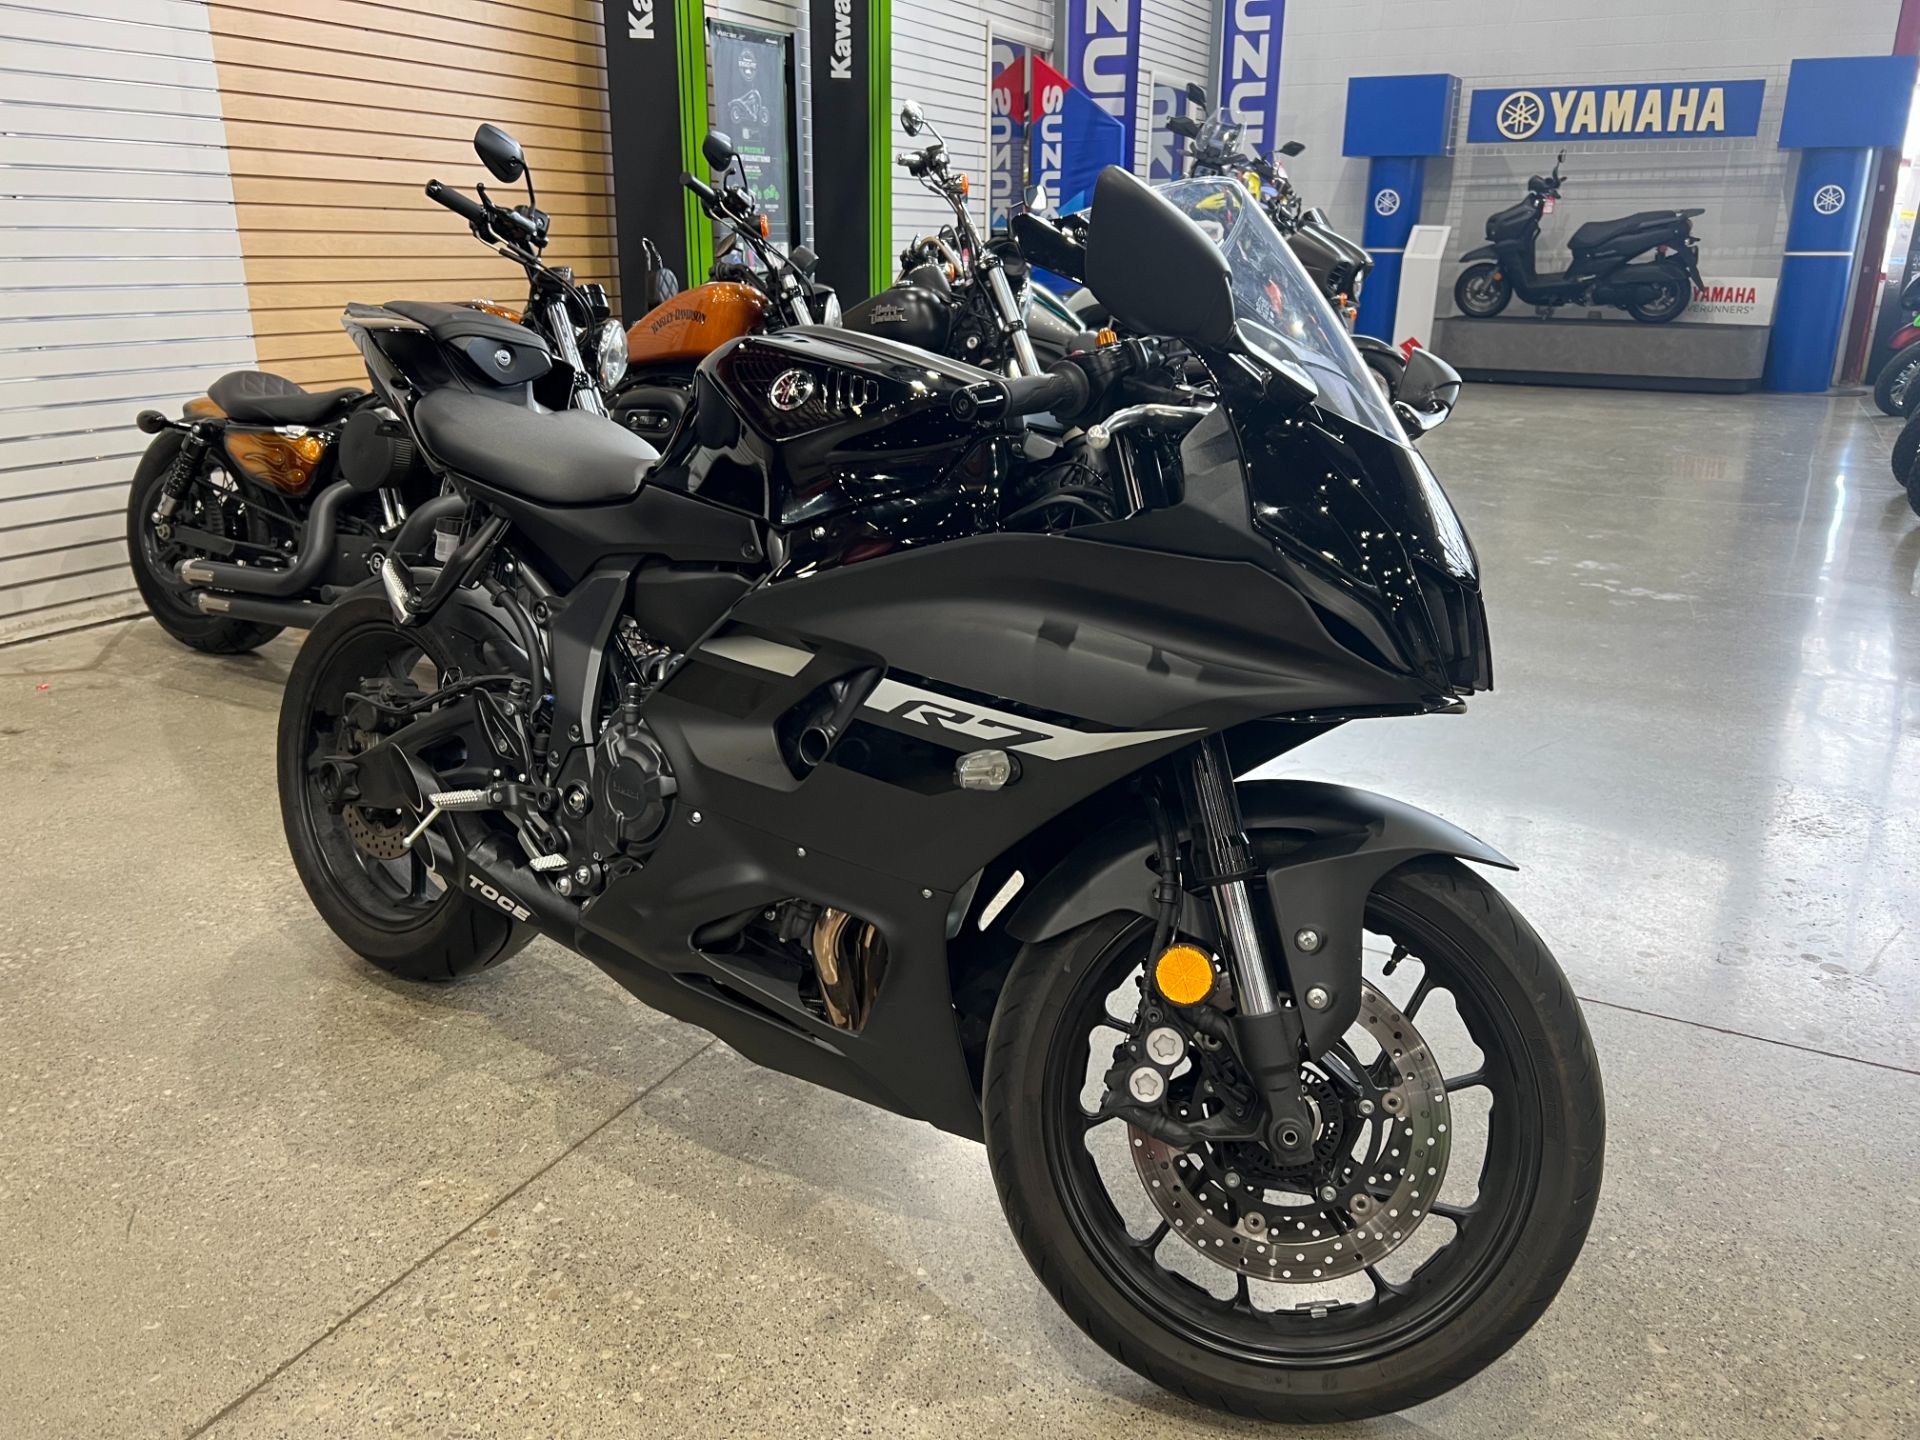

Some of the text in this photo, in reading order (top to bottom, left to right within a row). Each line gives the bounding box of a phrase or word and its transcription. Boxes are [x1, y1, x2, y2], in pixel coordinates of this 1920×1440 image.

[628, 0, 655, 39] Ka
[830, 0, 852, 79] Kawa
[1549, 87, 1726, 135] YAMAHA
[1692, 286, 1756, 304] YAMAHA
[887, 700, 1055, 748] R7
[468, 874, 532, 922] TOCE
